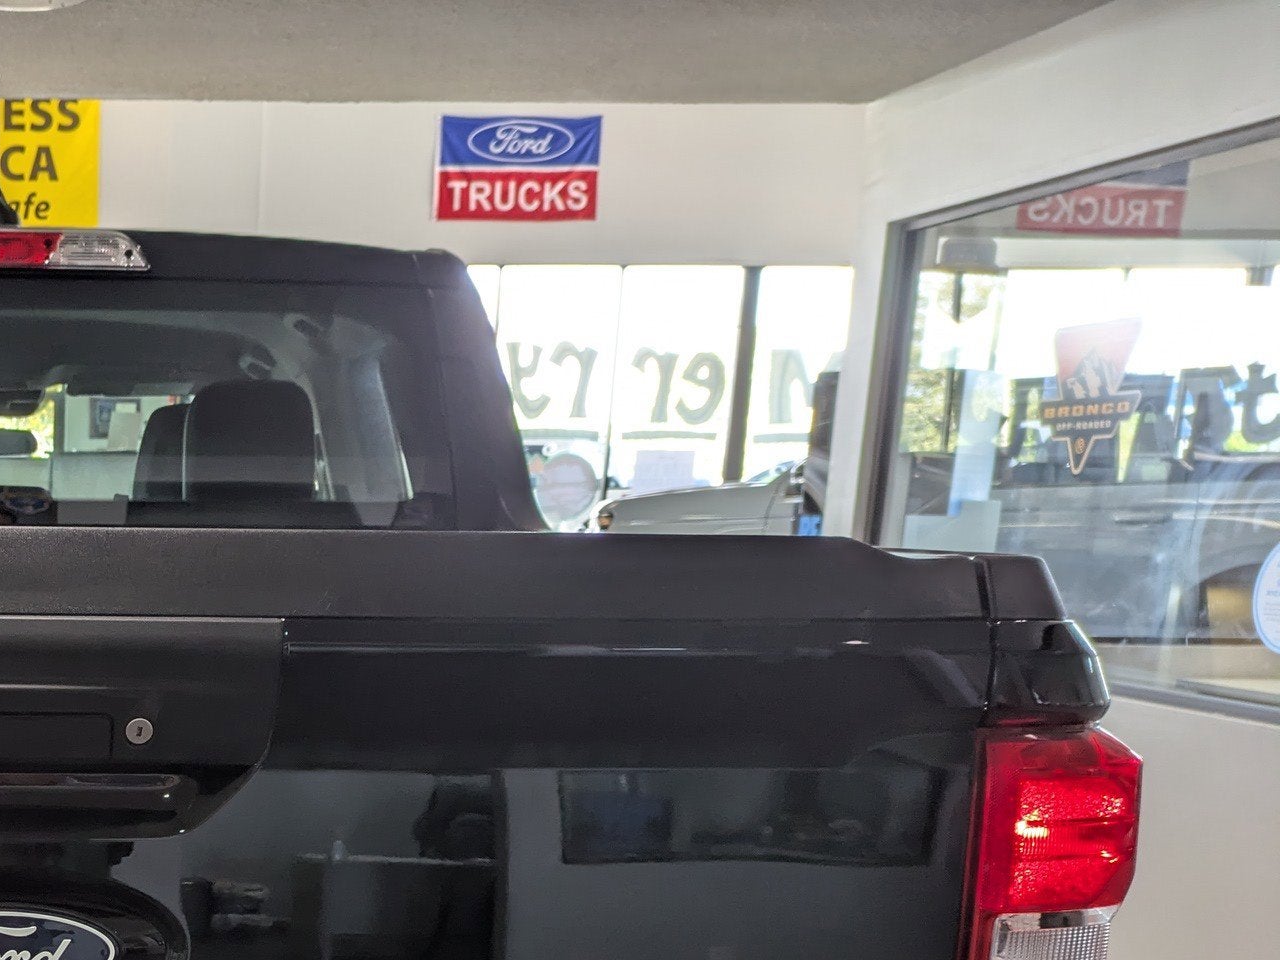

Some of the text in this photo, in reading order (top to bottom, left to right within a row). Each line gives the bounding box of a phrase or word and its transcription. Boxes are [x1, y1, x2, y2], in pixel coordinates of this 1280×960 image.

[489, 124, 554, 154] Ford
[447, 180, 589, 212] TRUCKS
[1043, 401, 1131, 419] BRONCO
